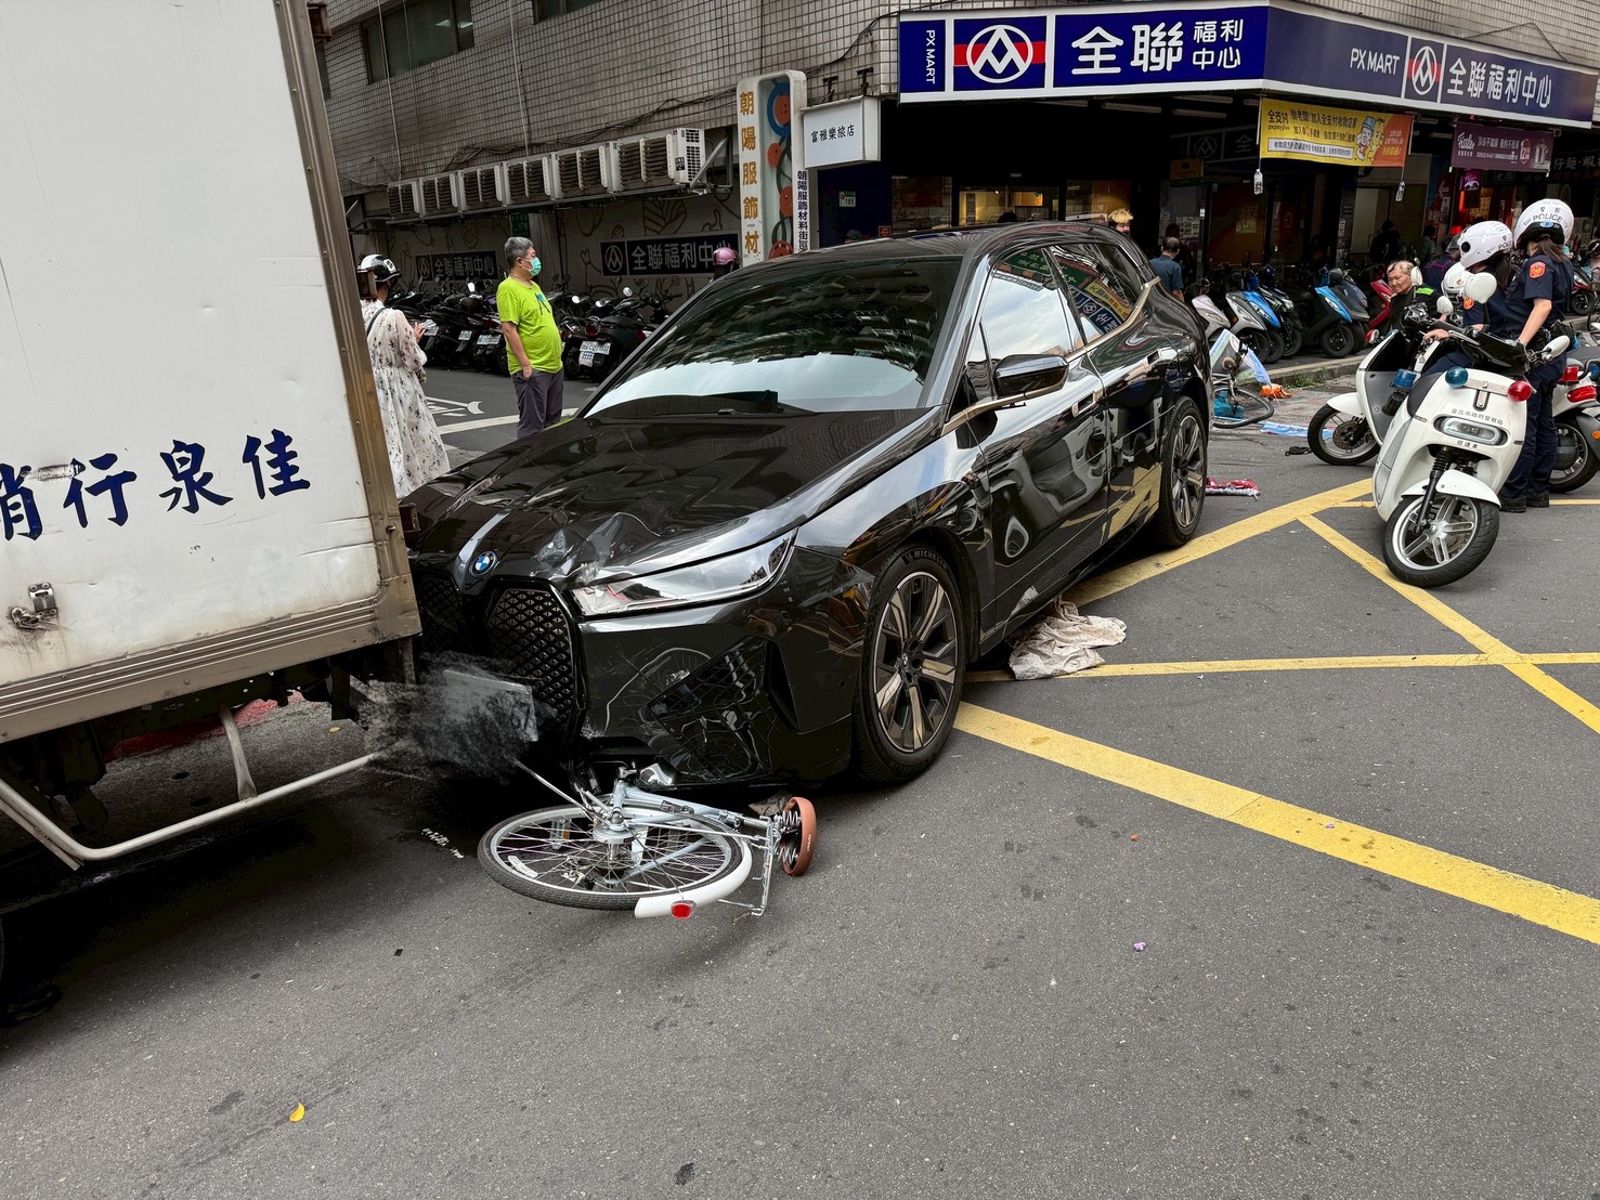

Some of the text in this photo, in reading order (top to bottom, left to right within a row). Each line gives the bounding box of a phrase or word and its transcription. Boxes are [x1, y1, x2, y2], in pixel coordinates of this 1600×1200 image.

[1071, 21, 1184, 75] 全聯
[1193, 19, 1243, 42] 福利
[926, 29, 936, 84] PX MART
[1192, 47, 1241, 70] 中心
[1350, 48, 1400, 75] PX MART
[1447, 57, 1552, 108] 全聯福利中心
[740, 91, 760, 254] 朝陽服飾材
[1533, 212, 1563, 223] POLICE
